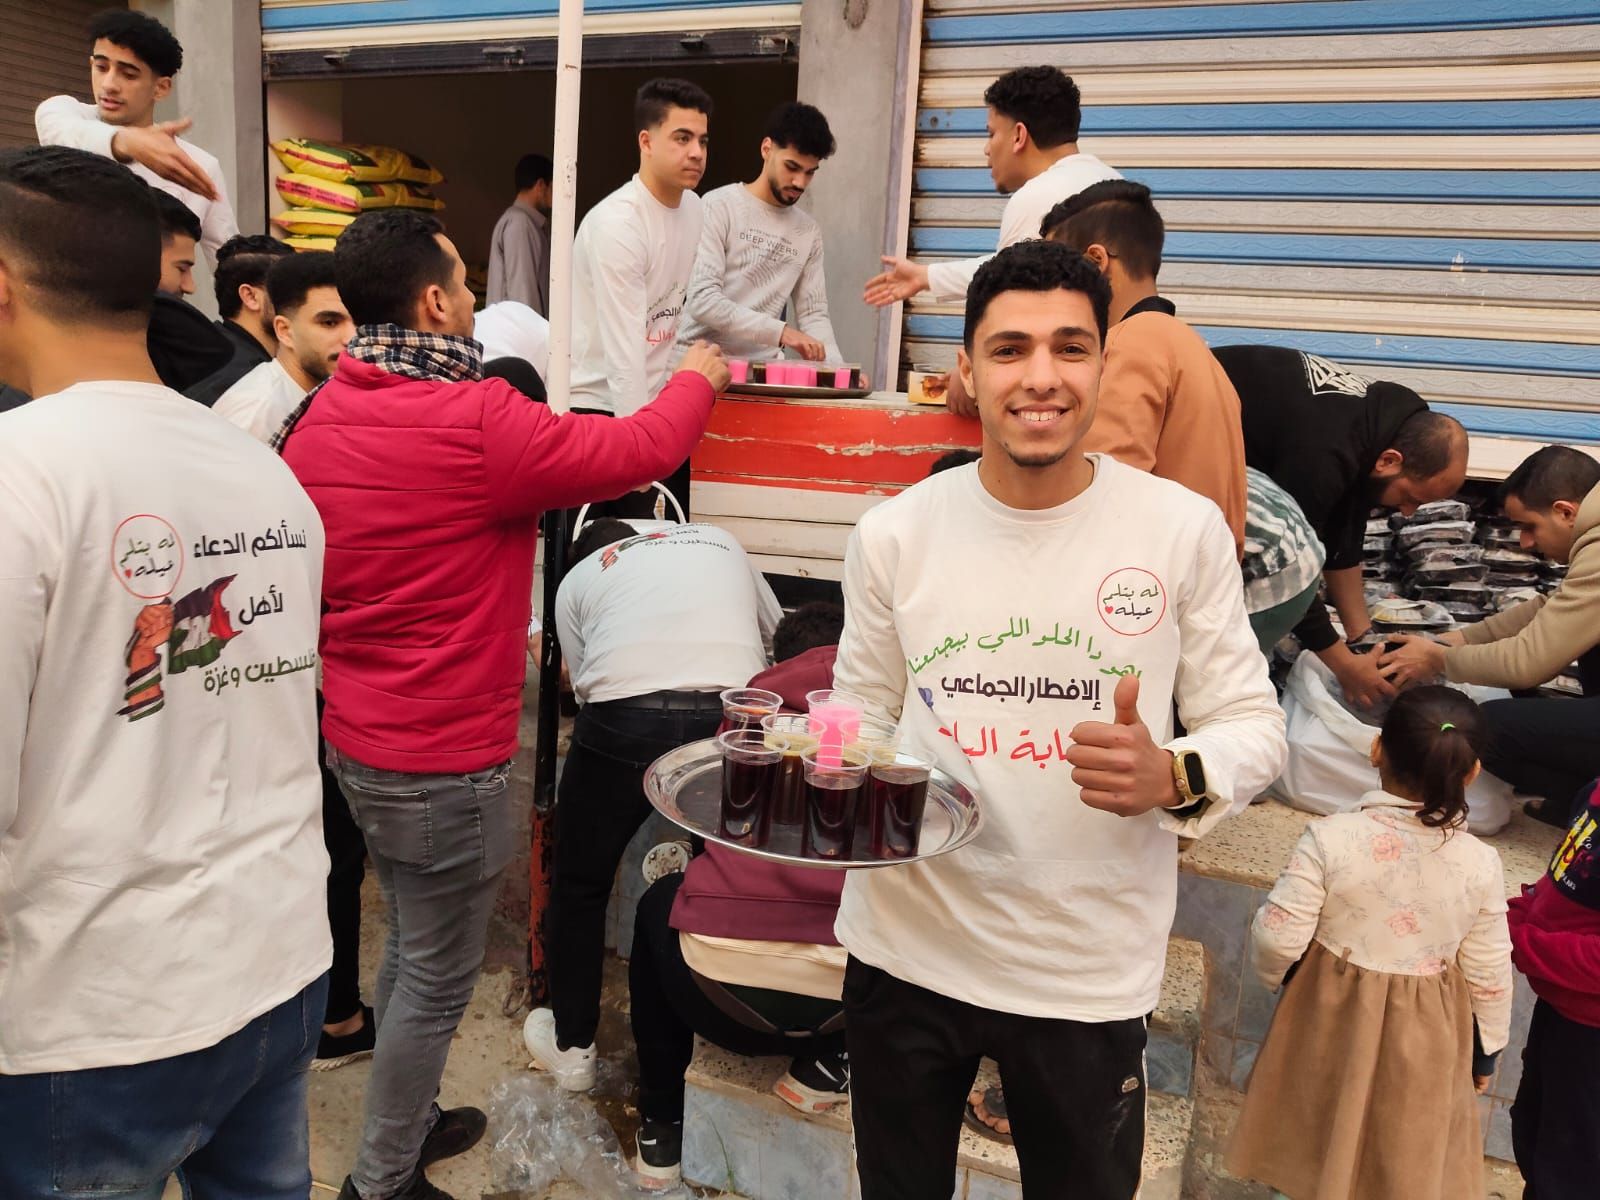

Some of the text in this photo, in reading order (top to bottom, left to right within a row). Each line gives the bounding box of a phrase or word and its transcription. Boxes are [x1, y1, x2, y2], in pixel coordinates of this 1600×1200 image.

[739, 232, 764, 245] DEEP
[194, 519, 307, 558] نسألكم الدعاء
[238, 584, 283, 625] لأهل
[1115, 602, 1152, 620] عيله
[977, 616, 1030, 653] اللي
[1032, 622, 1080, 648] الحلو
[908, 633, 968, 674] بيجمعنا
[941, 673, 1026, 703] الجماعي
